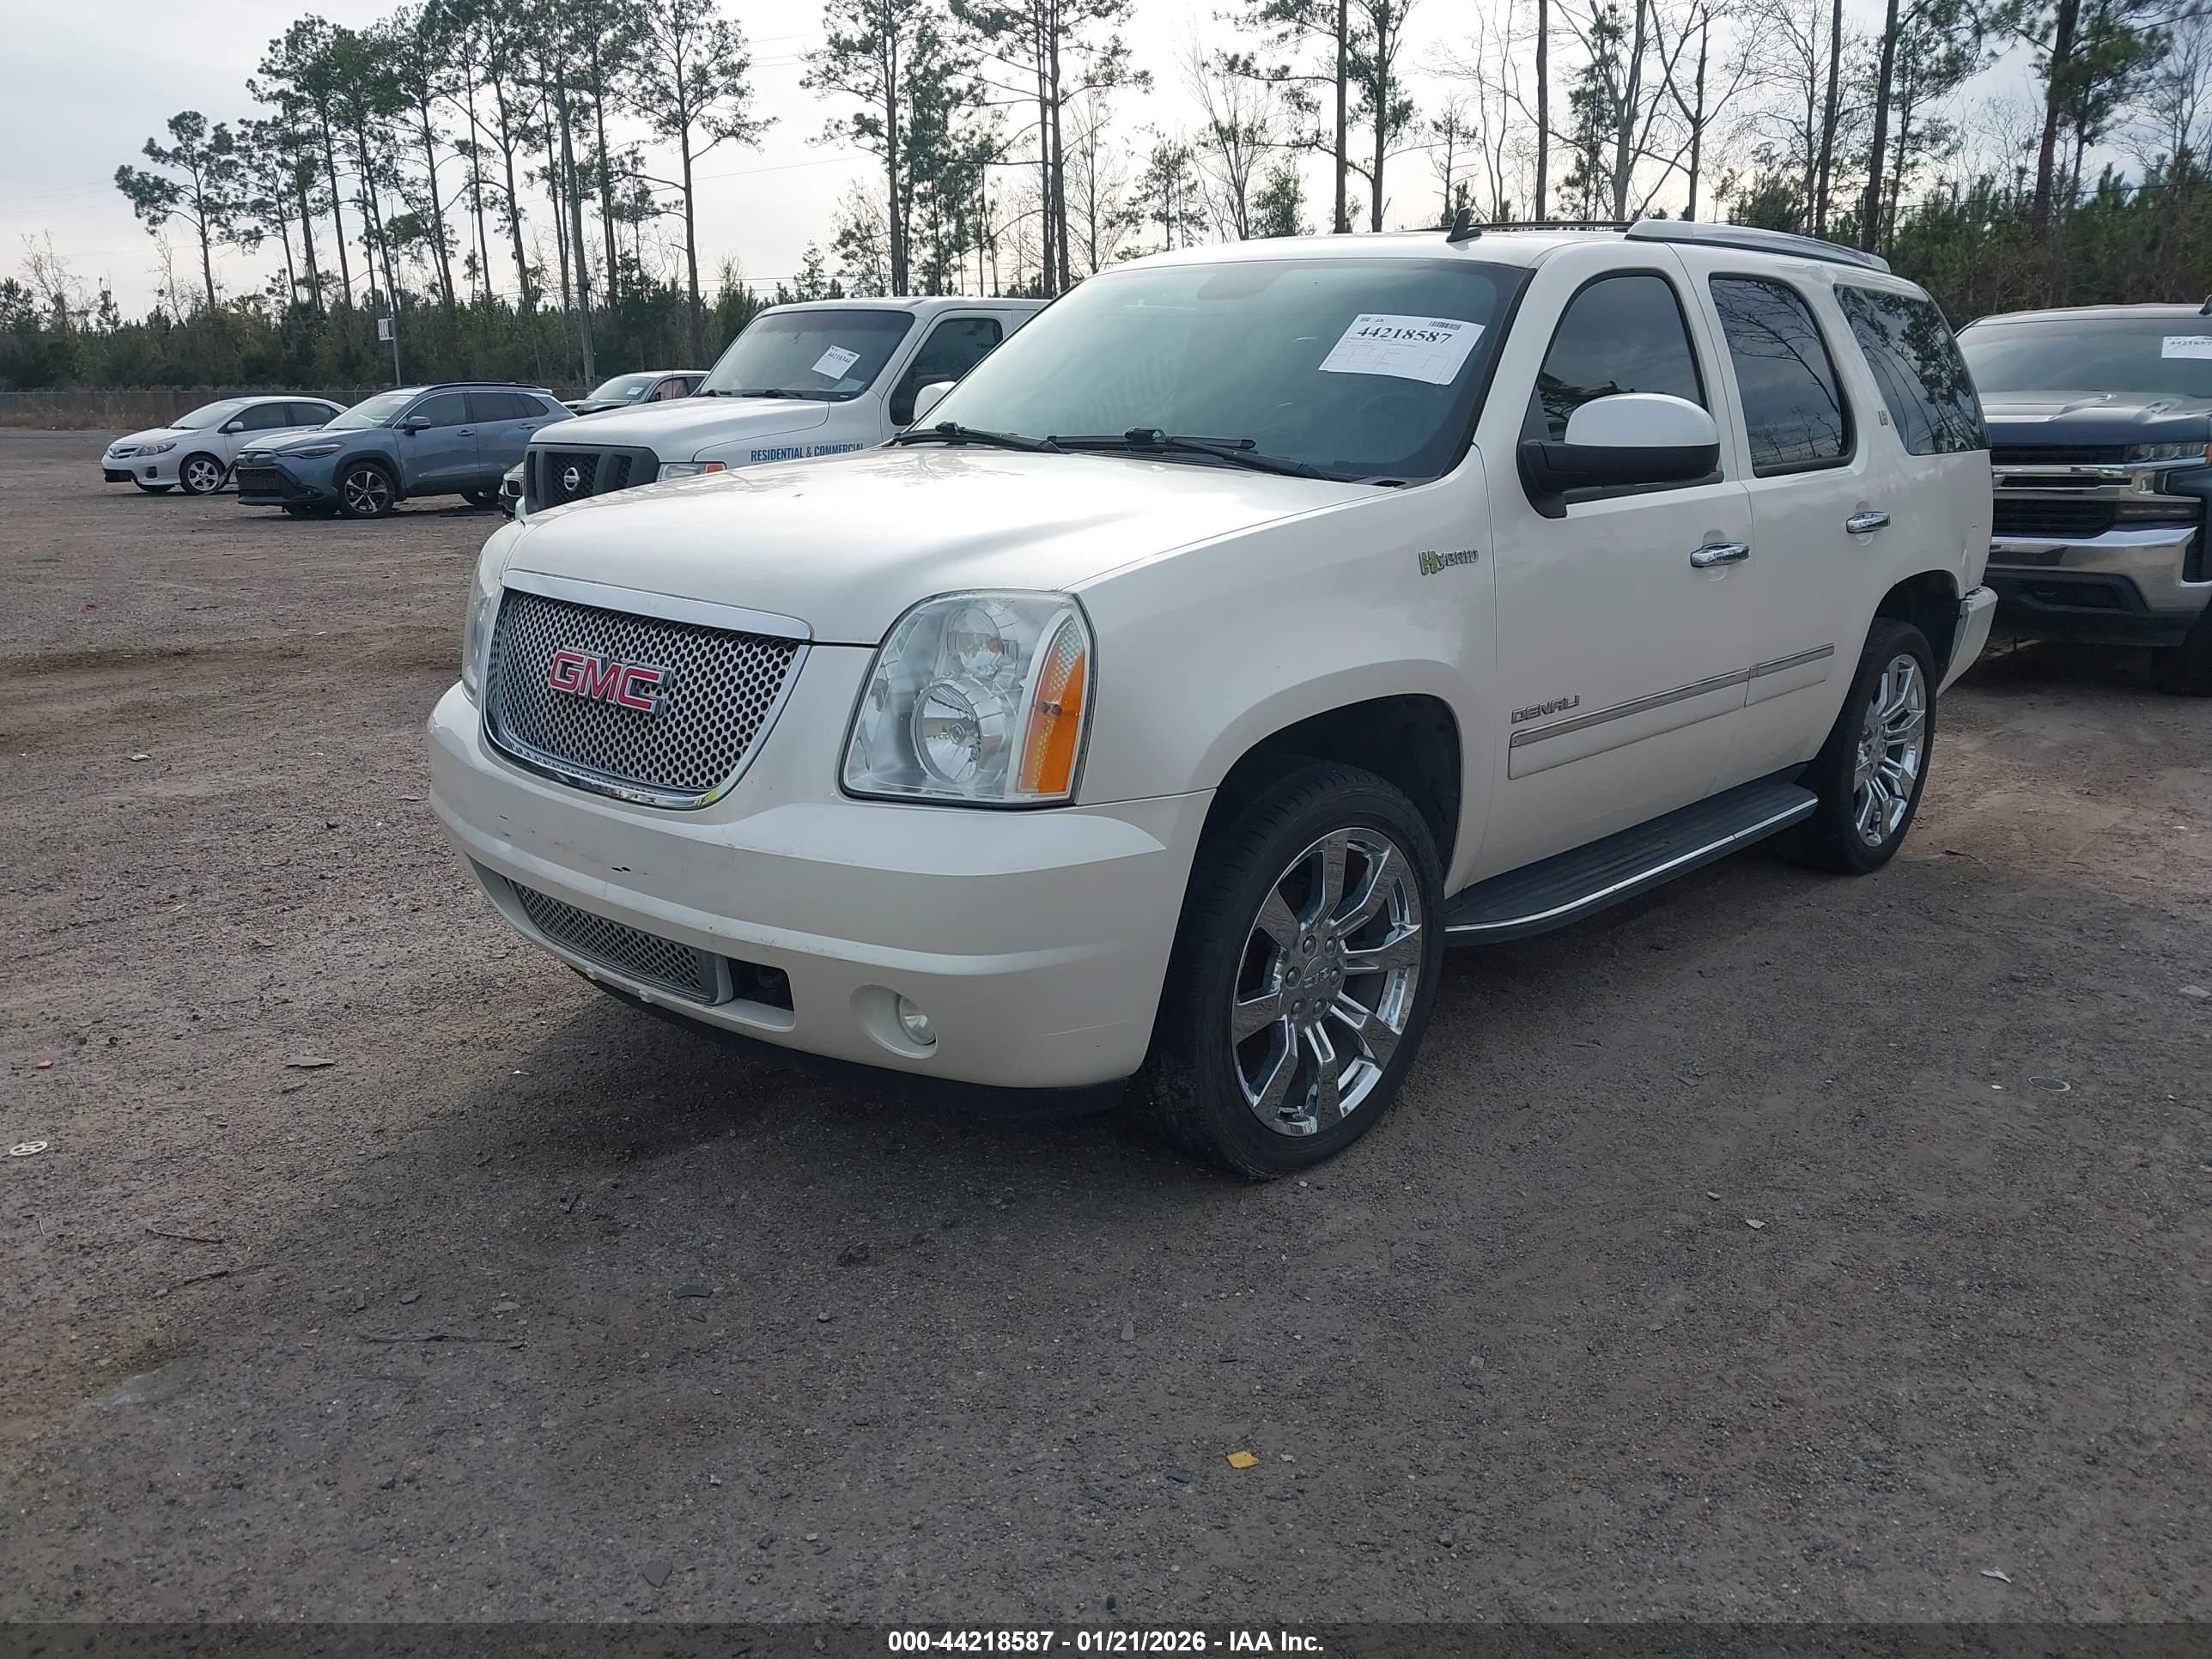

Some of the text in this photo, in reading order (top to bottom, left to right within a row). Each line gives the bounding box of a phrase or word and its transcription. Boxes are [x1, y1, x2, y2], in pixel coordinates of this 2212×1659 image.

[380, 320, 388, 337] 10
[1357, 326, 1453, 343] 44218587
[751, 447, 805, 462] RESIDENTIAL
[806, 447, 812, 457] &
[550, 648, 666, 715] GMC
[1511, 694, 1580, 724] DENALI
